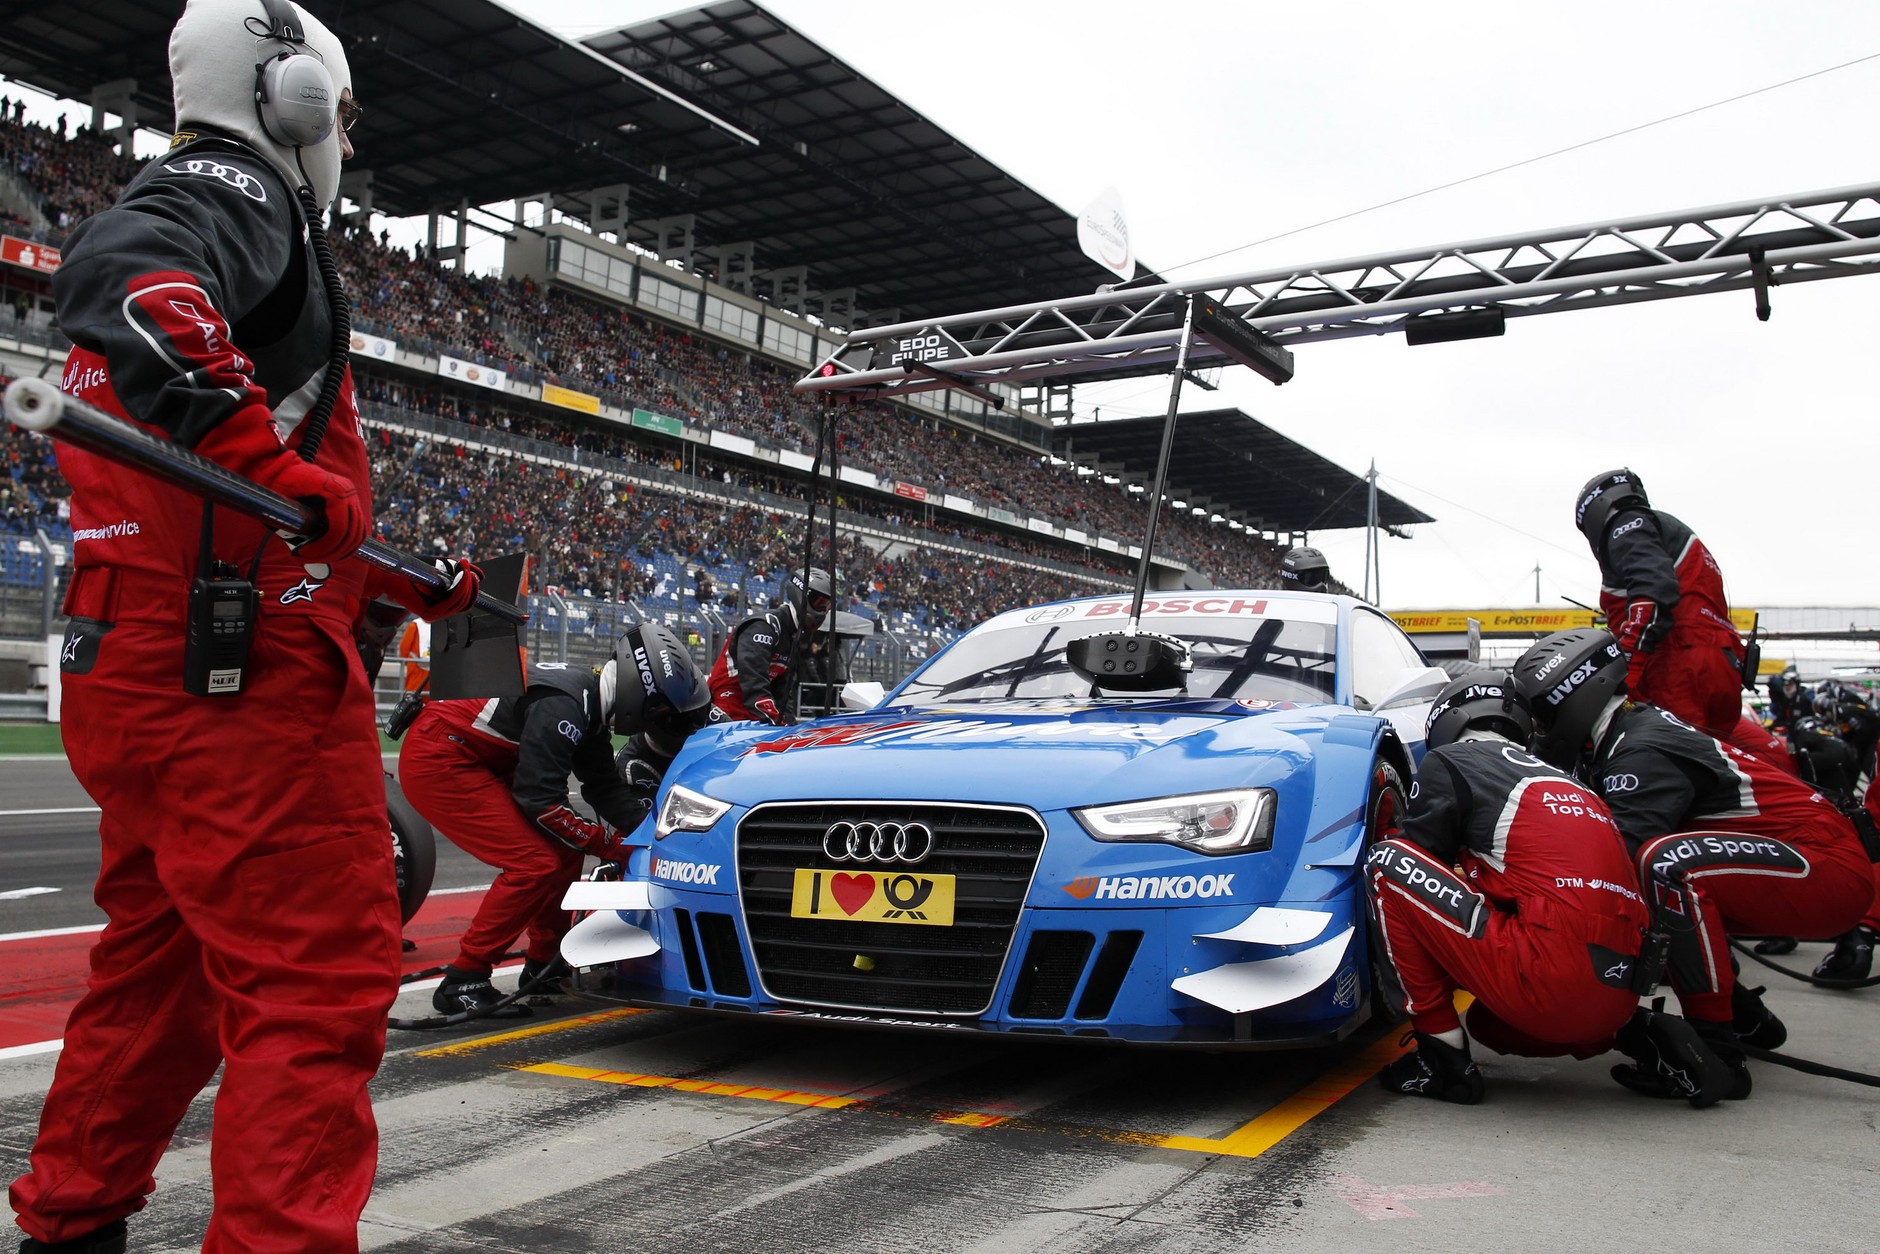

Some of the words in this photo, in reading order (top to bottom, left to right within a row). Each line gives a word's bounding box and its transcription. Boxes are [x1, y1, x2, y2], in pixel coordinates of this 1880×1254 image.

[899, 335, 940, 351] EDO
[891, 346, 949, 365] FILIPE
[1085, 599, 1268, 617] BOSCH
[633, 646, 658, 696] uvex
[660, 649, 674, 678] uvex
[1534, 652, 1567, 681] uvex
[1464, 684, 1505, 699] uve
[1546, 659, 1598, 705] uvex
[1542, 791, 1585, 804] Audi
[1544, 803, 1584, 817] Top
[1652, 840, 1702, 878] Audi
[1703, 837, 1780, 858] Sport
[1395, 856, 1463, 908] Sport
[1555, 877, 1584, 888] DTM
[810, 872, 821, 914] I
[874, 1018, 960, 1029] Sport
